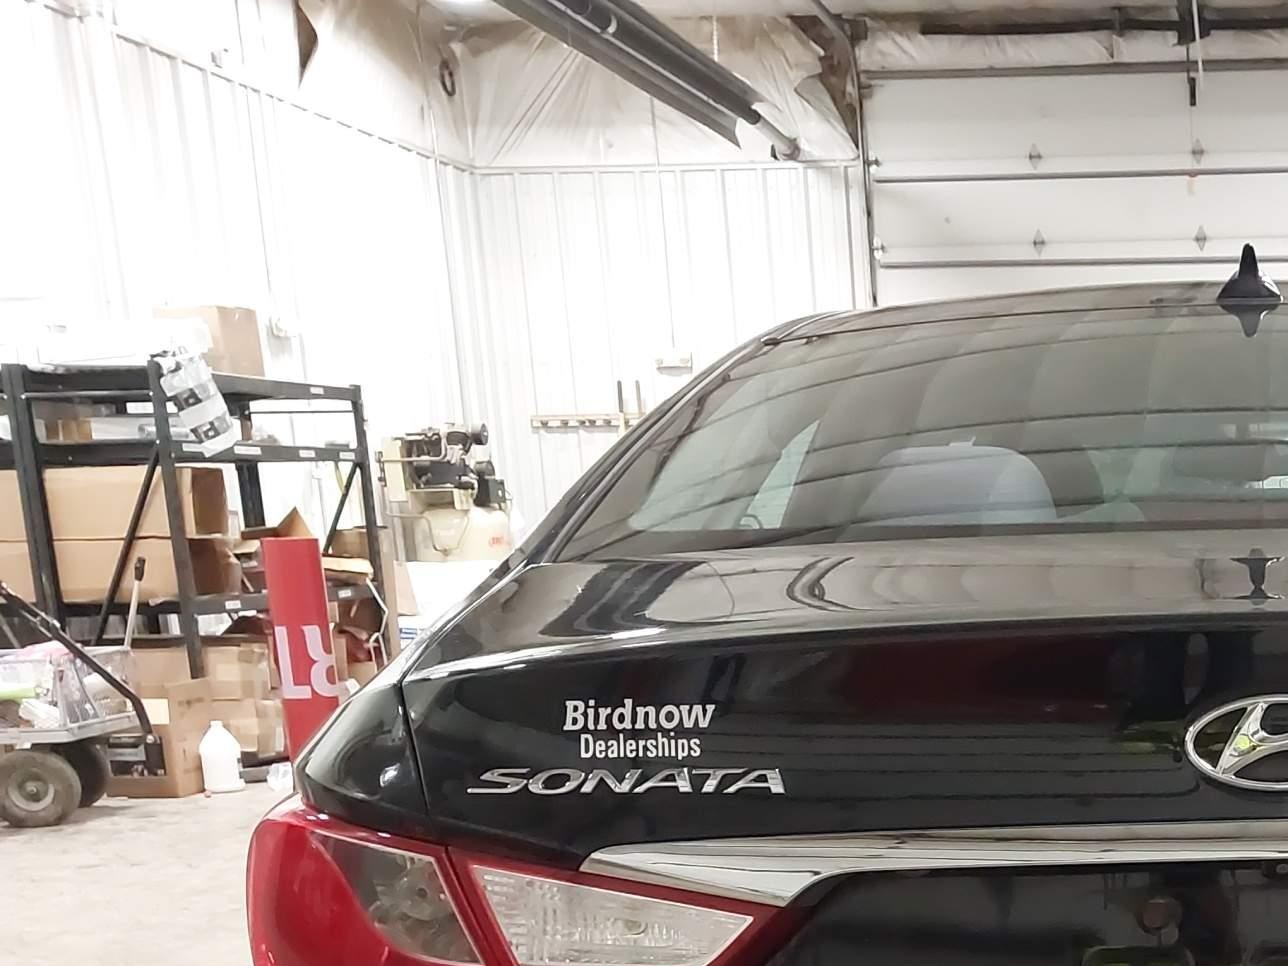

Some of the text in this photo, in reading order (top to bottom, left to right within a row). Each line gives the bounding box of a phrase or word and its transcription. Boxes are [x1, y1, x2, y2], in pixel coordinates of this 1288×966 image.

[563, 698, 716, 731] Birdnow
[580, 732, 702, 760] Dealerships
[466, 767, 787, 796] SONATA
